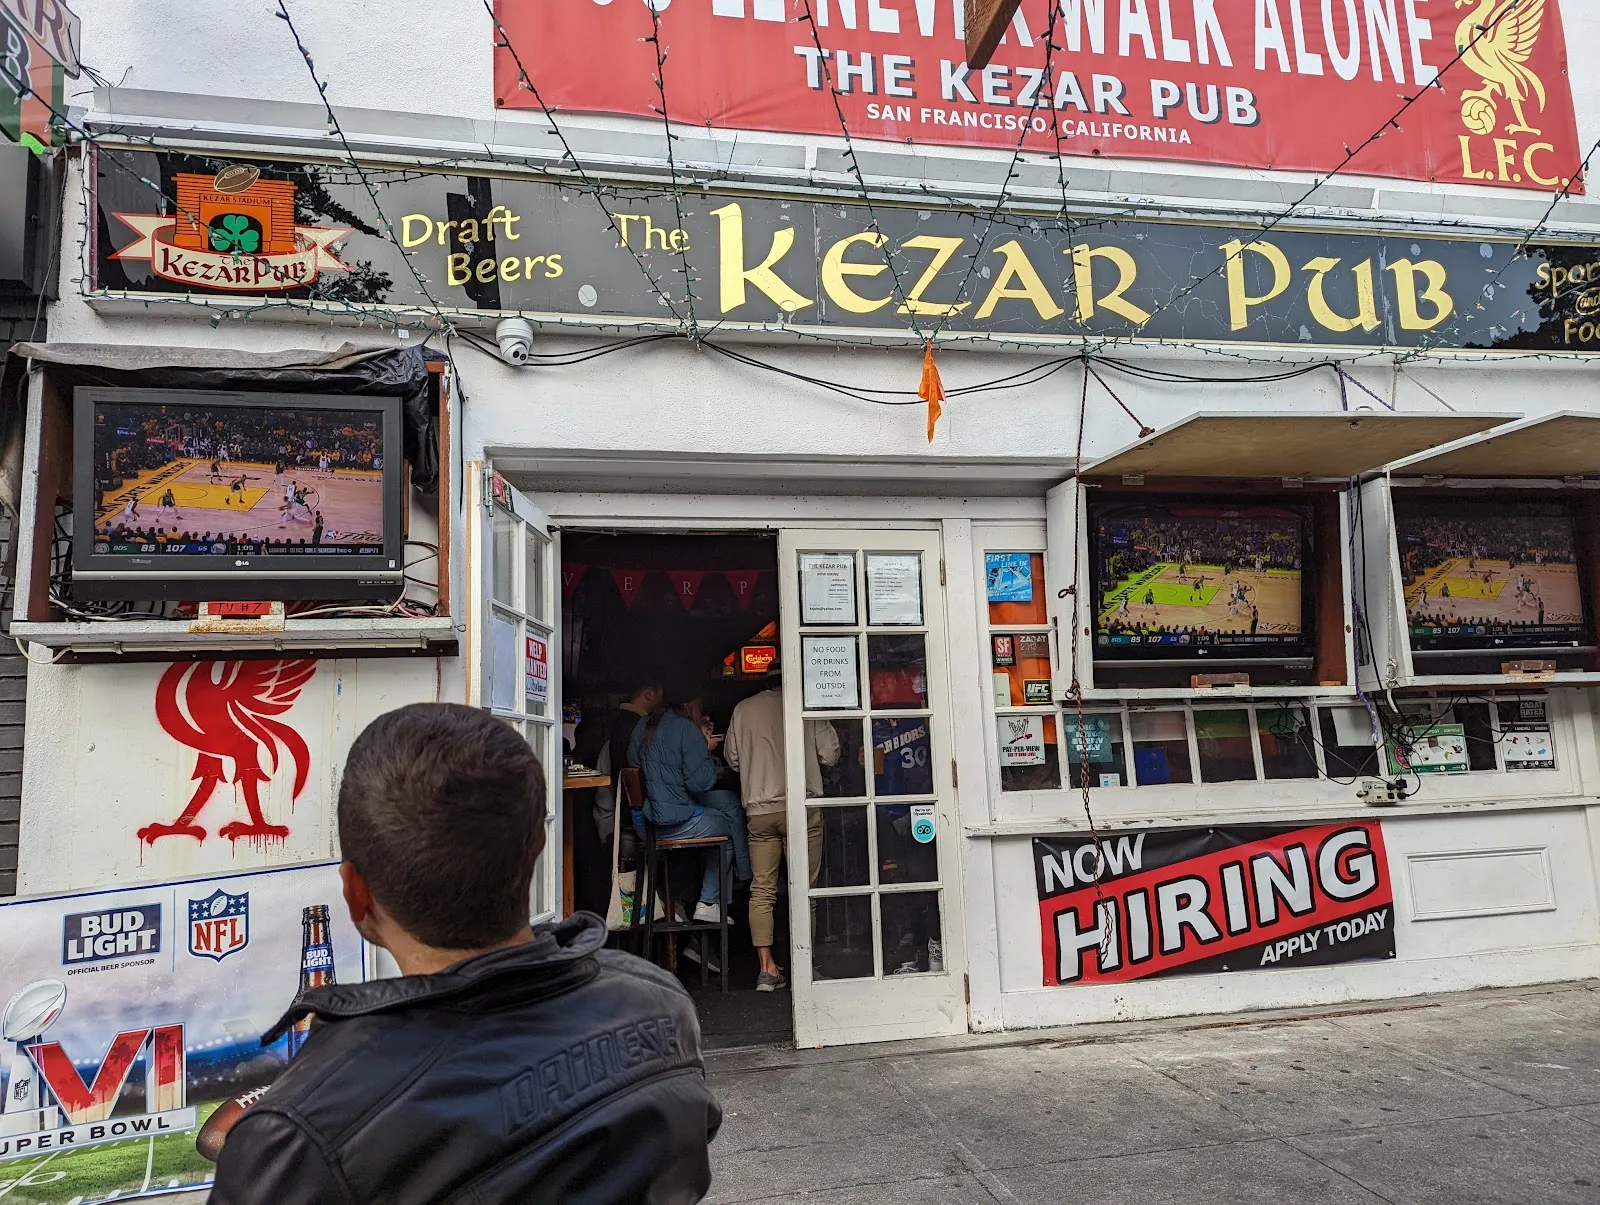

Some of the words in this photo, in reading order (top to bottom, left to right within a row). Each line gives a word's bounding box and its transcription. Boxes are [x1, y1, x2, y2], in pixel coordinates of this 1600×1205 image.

[1254, 0, 1439, 87] ALONE
[793, 45, 915, 98] THE
[940, 58, 1132, 117] KEZAR
[1150, 78, 1259, 127] PUB
[867, 103, 911, 122] SAN
[1062, 119, 1192, 144] CALIFORNIA
[1457, 134, 1570, 186] L.F.C.
[203, 194, 231, 203] KEZAR
[232, 195, 271, 205] STADIUM
[401, 205, 521, 248] Draft
[447, 252, 564, 287] Beers
[612, 212, 691, 251] The
[709, 202, 1152, 325] KEZAR
[1219, 238, 1455, 333] PUB
[141, 544, 156, 552] 85
[166, 544, 186, 552] 107
[986, 553, 1012, 563] FIRST
[215, 602, 234, 613] TV
[997, 637, 1010, 654] SF
[1020, 635, 1047, 643] ZAGAT
[815, 682, 847, 690] OUTSIDE
[1027, 683, 1049, 693] UFC
[900, 745, 928, 769] 30
[1002, 745, 1041, 753] PAY-PER-VIEW
[1041, 833, 1145, 894] NOW
[1055, 828, 1377, 982] HIRING
[81, 910, 145, 937] BUD
[194, 917, 244, 953] NFL
[67, 929, 156, 960] LIGHT
[1260, 930, 1322, 965] APPLY
[1323, 909, 1389, 946] TODAY
[302, 956, 332, 969] LIGHT
[306, 948, 329, 960] BUD
[67, 965, 99, 976] OFFICIAL
[101, 963, 120, 972] BEER
[120, 958, 155, 969] SPONSOR
[89, 1115, 171, 1141] BOWL
